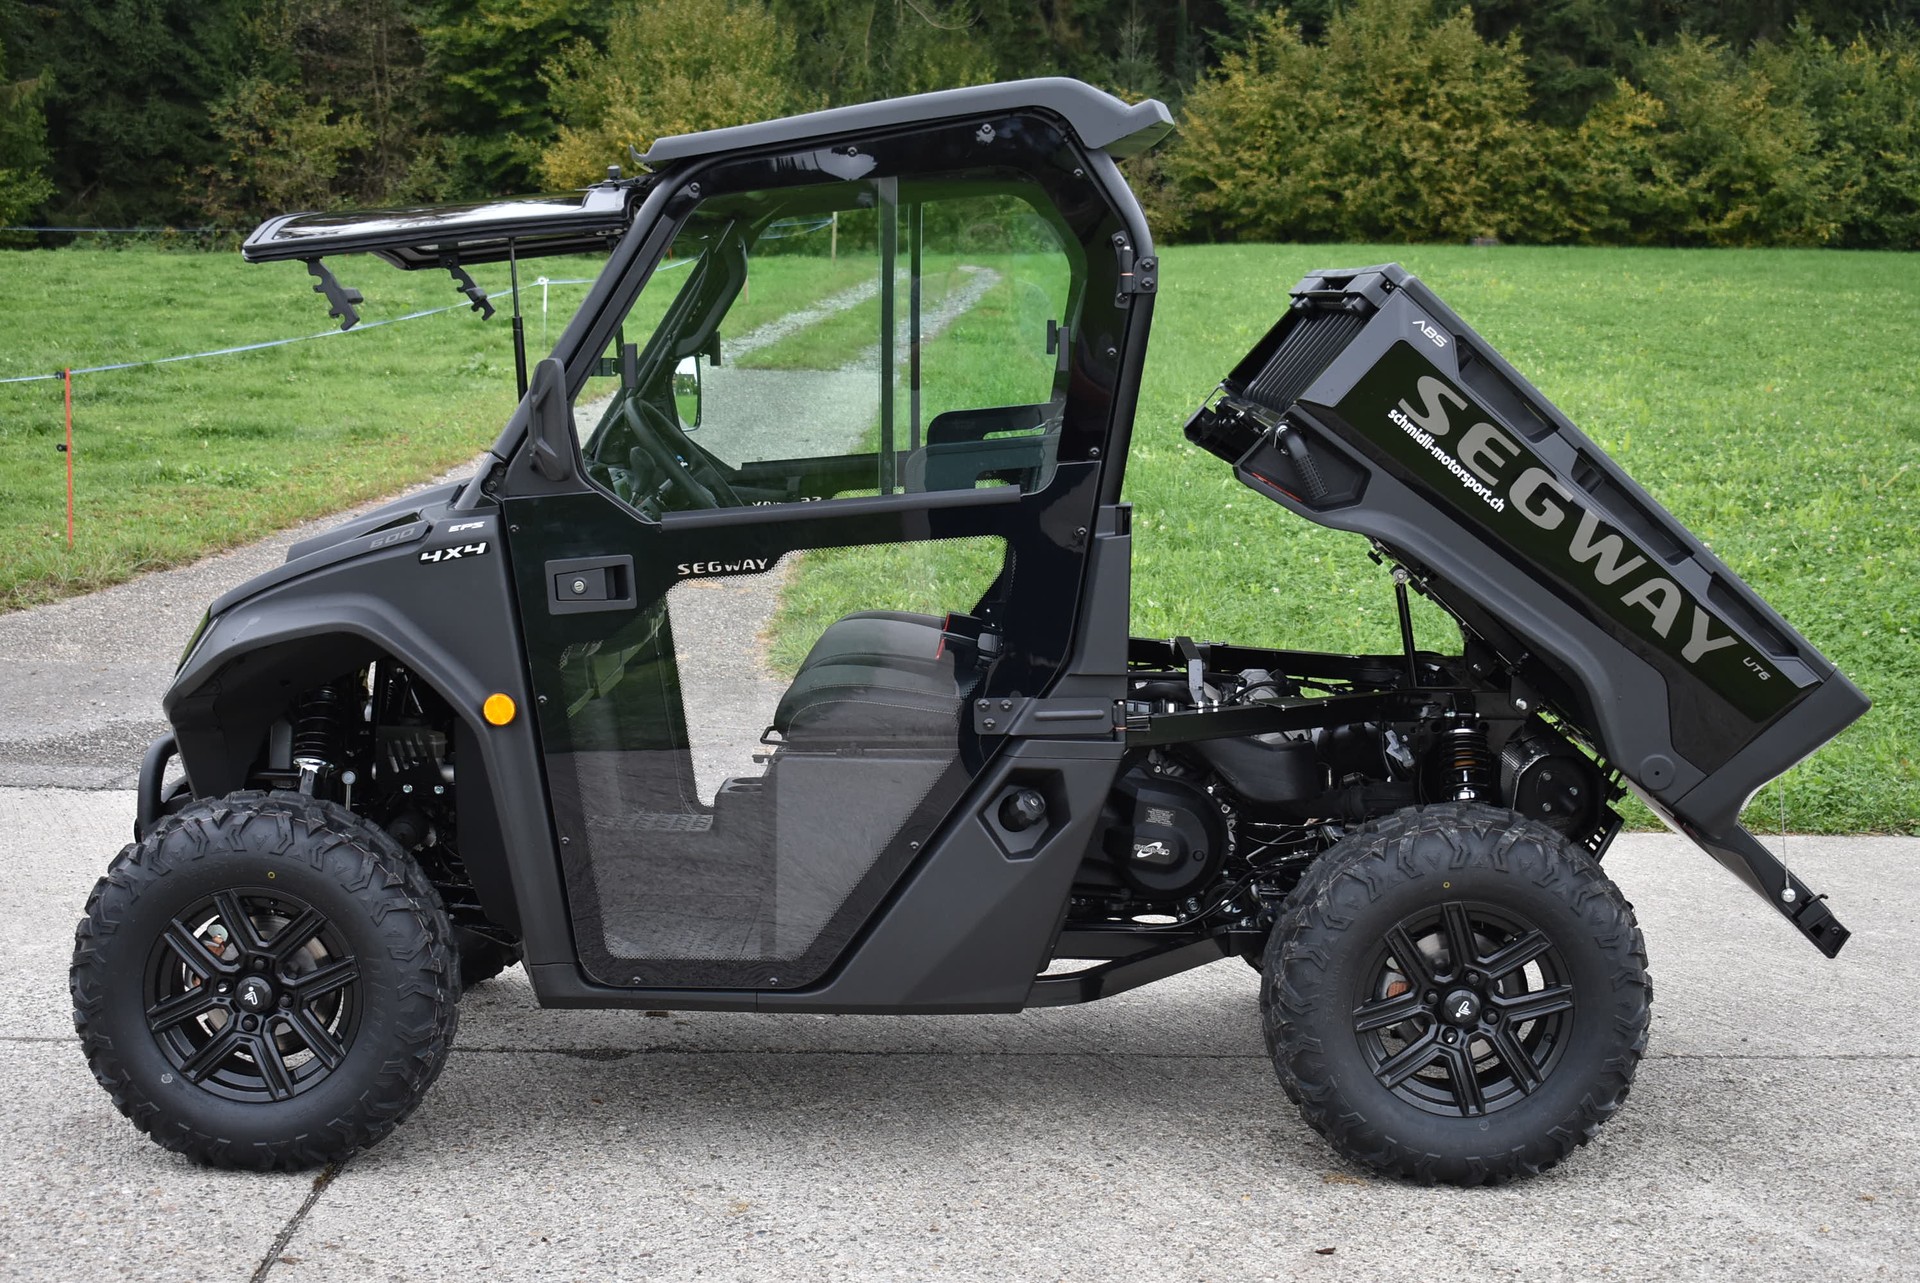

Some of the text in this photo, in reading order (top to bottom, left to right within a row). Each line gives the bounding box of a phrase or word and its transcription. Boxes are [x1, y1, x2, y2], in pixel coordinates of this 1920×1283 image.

[1412, 320, 1448, 347] ABS
[1387, 409, 1505, 512] schmidli-motorsport.ch
[448, 521, 485, 533] EPS
[1398, 376, 1738, 663] SEGWAY
[677, 558, 768, 575] SEGWAY
[1742, 656, 1771, 680] UT6
